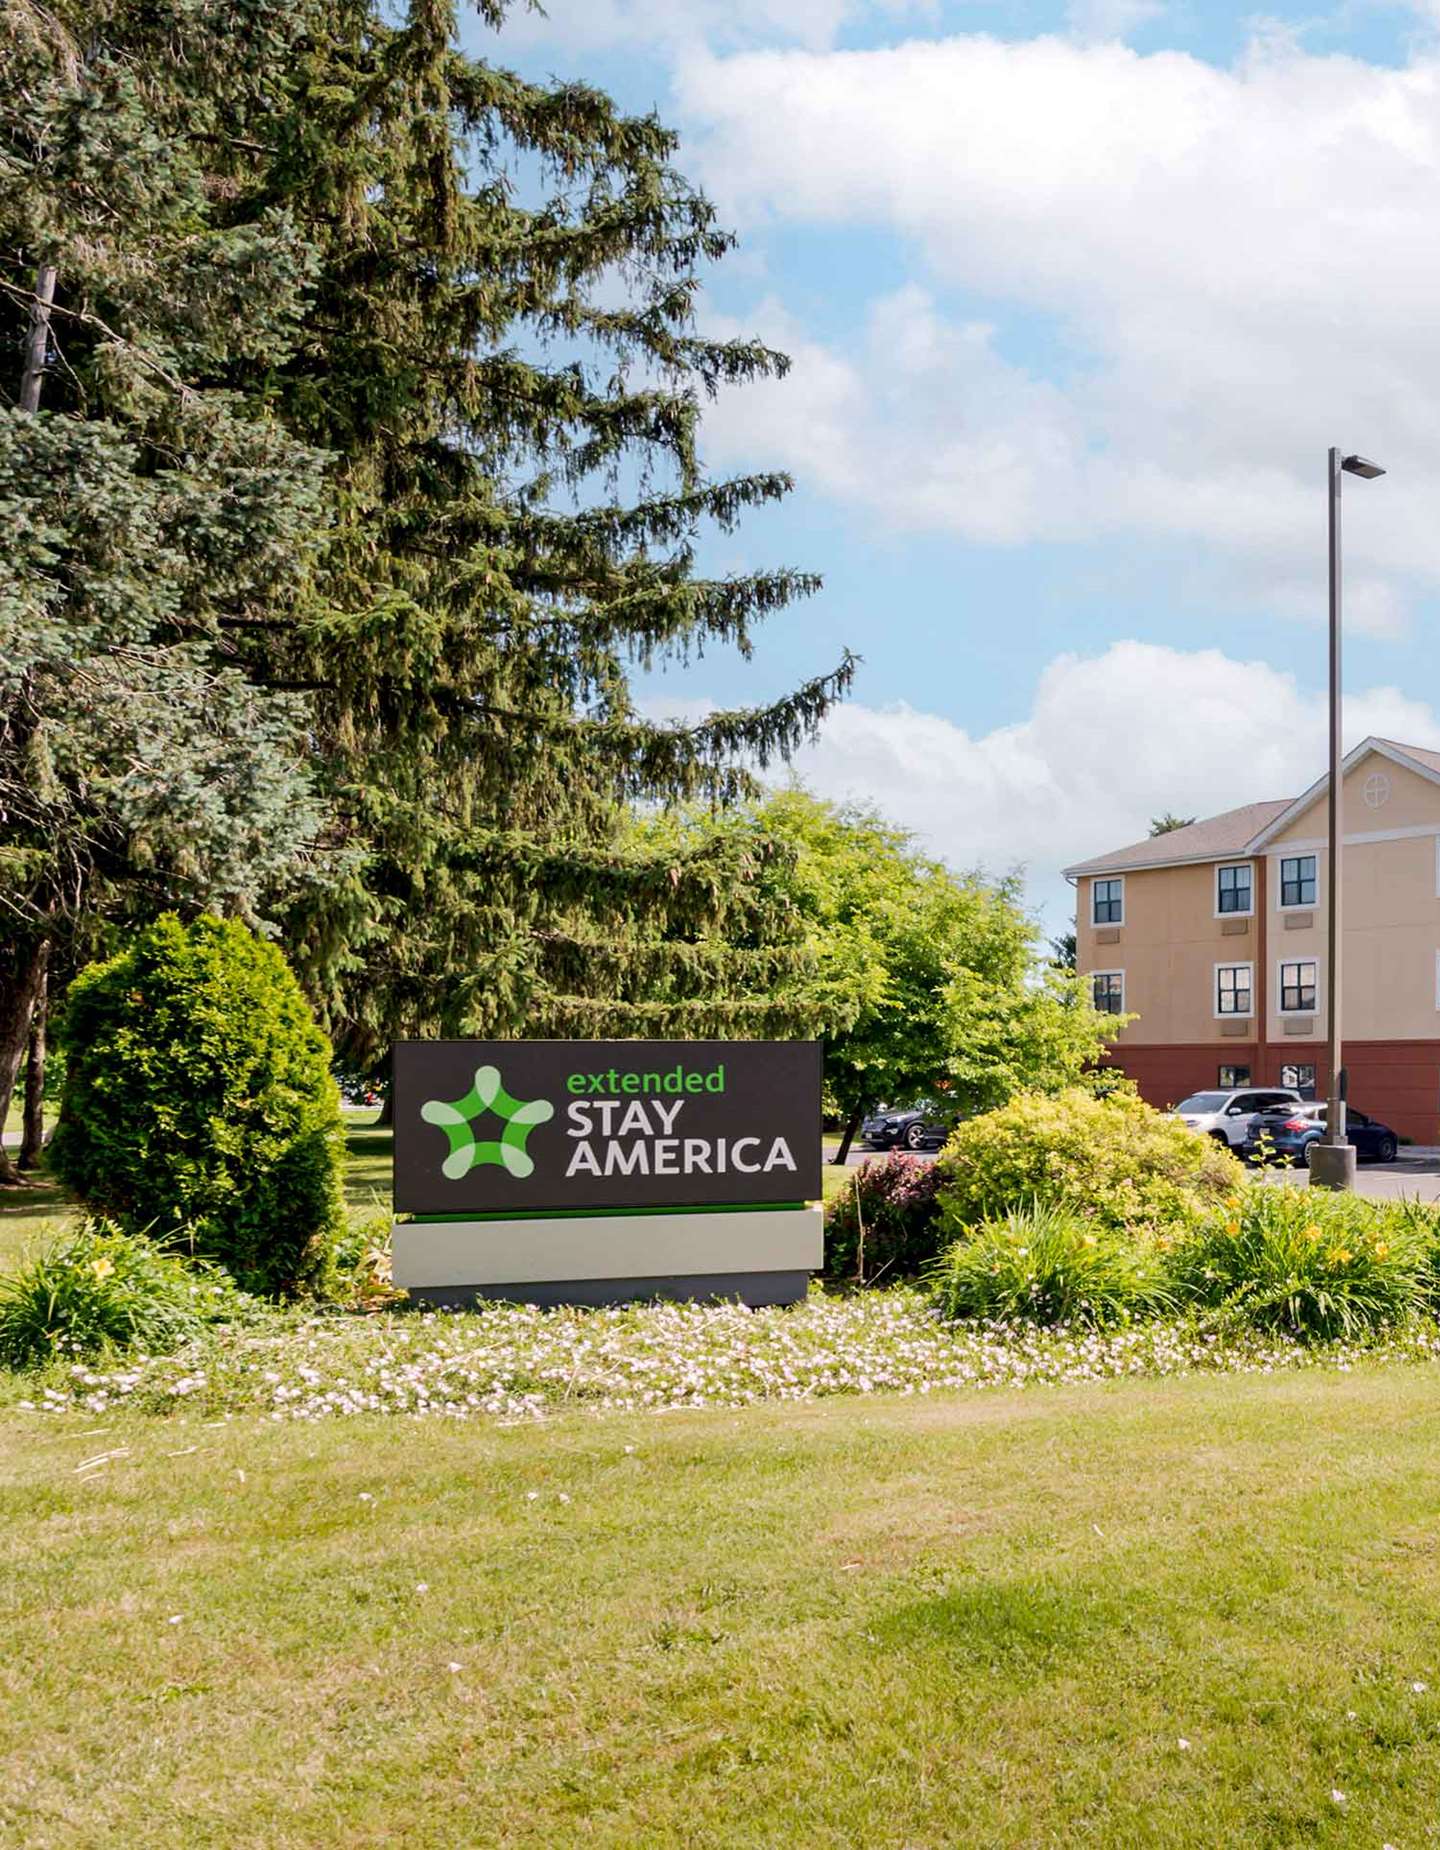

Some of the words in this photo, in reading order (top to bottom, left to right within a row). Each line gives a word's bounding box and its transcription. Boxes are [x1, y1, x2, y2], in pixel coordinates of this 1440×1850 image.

[566, 1064, 725, 1095] extended
[565, 1099, 686, 1138] STAY
[564, 1136, 798, 1177] AMERICA
